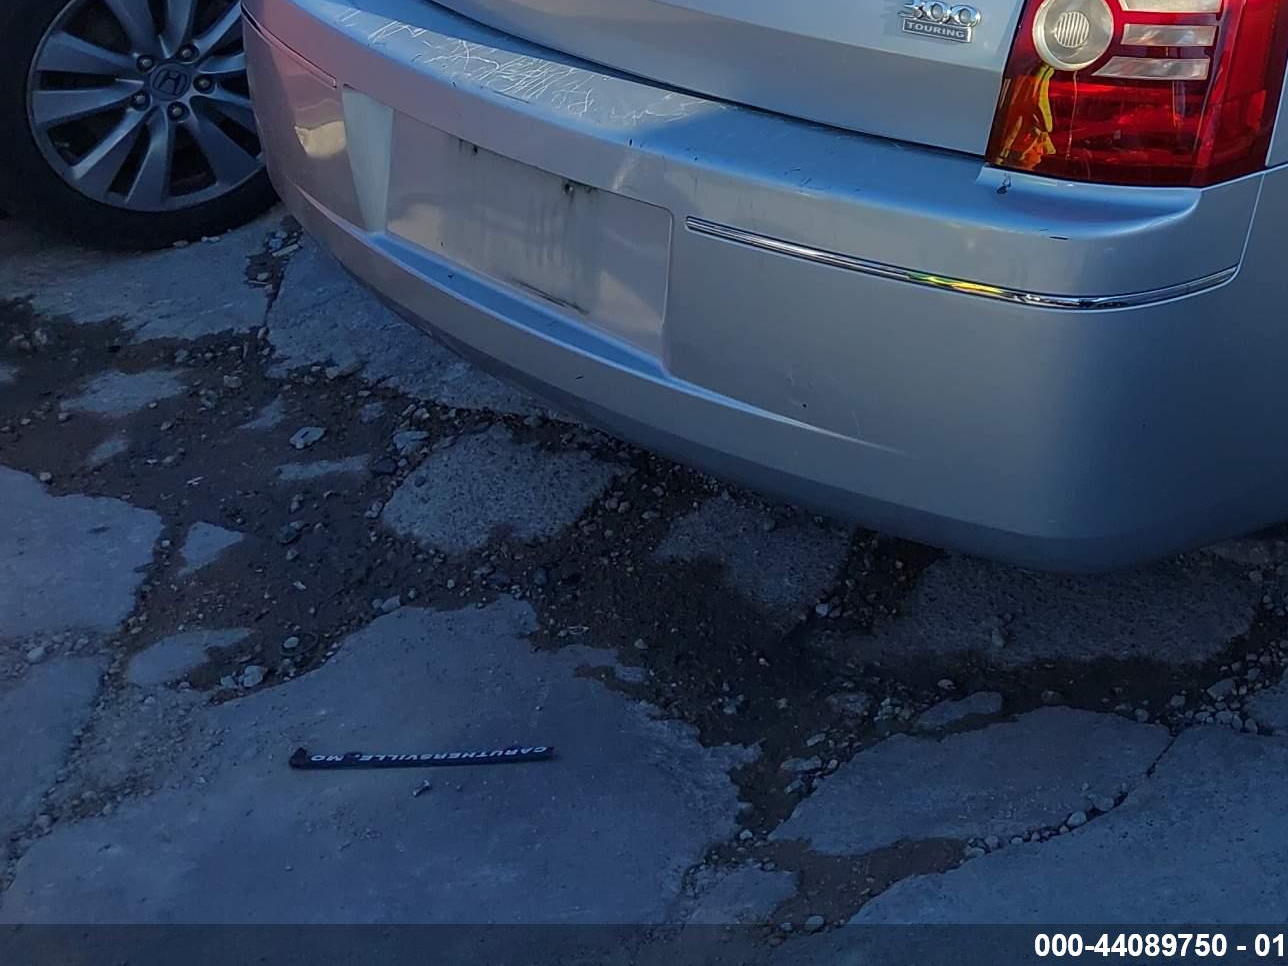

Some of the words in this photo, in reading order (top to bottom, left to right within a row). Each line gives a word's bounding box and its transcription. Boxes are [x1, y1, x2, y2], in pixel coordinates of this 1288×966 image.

[906, 20, 966, 39] TOURING
[311, 754, 344, 762] MO
[355, 746, 547, 761] CARUTHERSVILLE,
